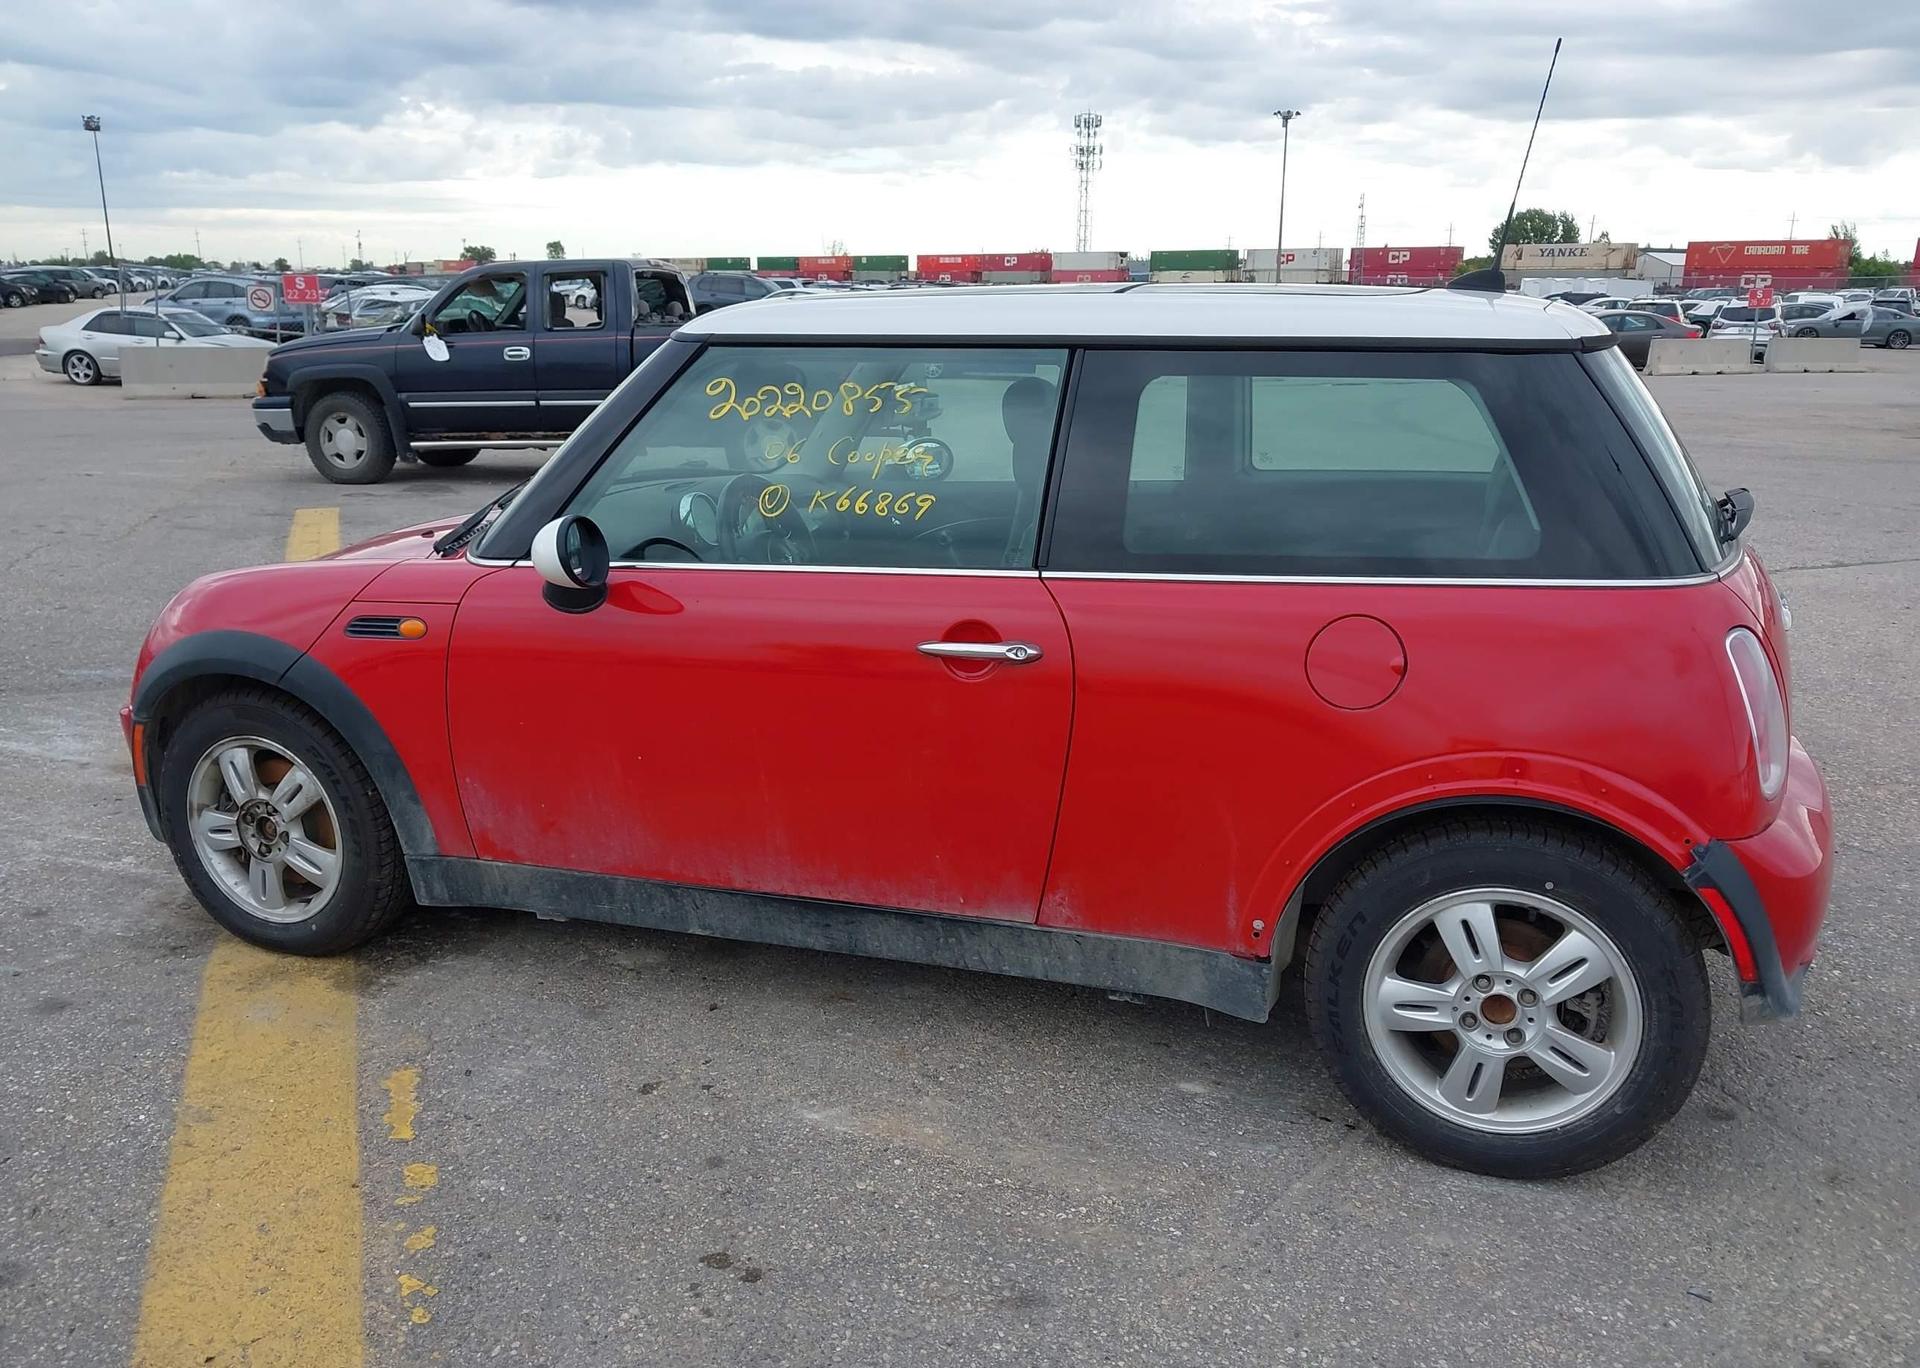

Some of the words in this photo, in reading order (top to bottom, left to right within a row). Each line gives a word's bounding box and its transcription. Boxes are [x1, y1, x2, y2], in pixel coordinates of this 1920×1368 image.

[1539, 247, 1589, 257] YANKE
[1791, 245, 1810, 254] TIRE
[1004, 256, 1018, 266] CP
[1388, 251, 1410, 264] CP
[295, 277, 306, 289] S
[1740, 274, 1772, 288] CP
[287, 289, 299, 299] 22
[305, 289, 317, 299] 23
[1756, 290, 1764, 299] S
[808, 486, 936, 521] K66869
